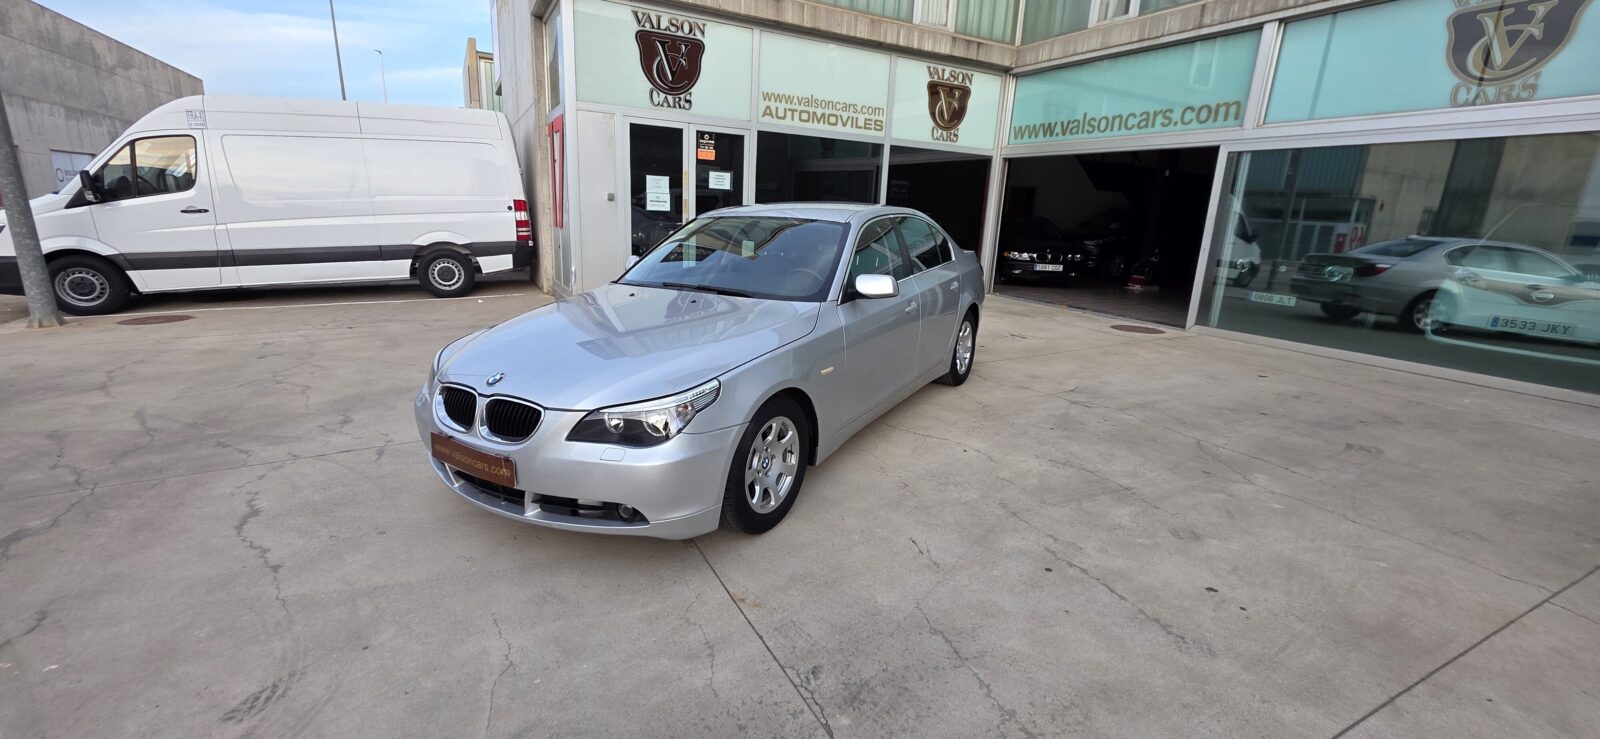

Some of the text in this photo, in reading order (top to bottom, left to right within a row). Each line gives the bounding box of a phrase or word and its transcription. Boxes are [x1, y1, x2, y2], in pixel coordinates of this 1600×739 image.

[631, 10, 707, 38] VALSON
[927, 66, 974, 86] VALSON
[1450, 71, 1543, 107] CARS
[649, 87, 692, 110] CARS
[761, 91, 885, 117] www.valsoncars.com
[761, 105, 884, 131] AUTOMOVILES
[1013, 100, 1242, 141] www.valsoncars.com
[931, 125, 960, 143] CARS
[1500, 318, 1571, 335] 3533 JKY
